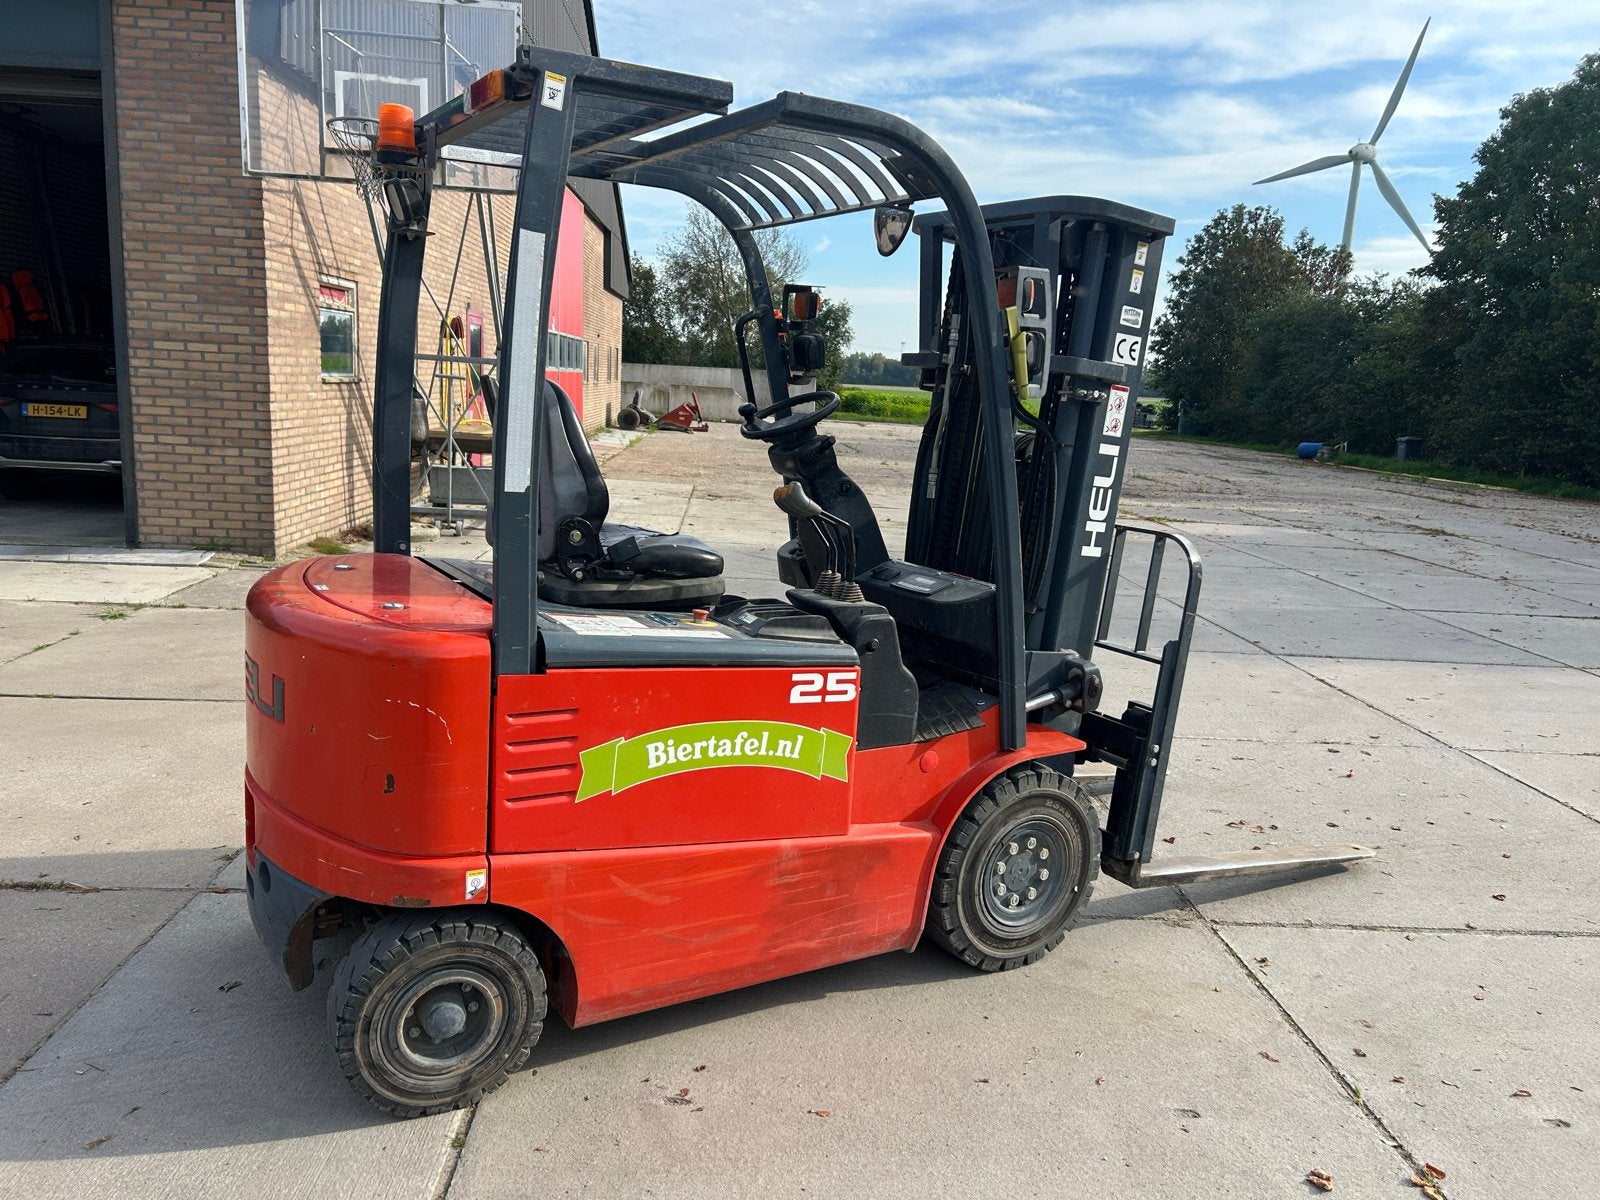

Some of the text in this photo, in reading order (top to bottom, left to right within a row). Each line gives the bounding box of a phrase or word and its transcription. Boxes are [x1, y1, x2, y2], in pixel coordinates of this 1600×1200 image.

[1117, 339, 1138, 361] CE
[32, 405, 81, 417] H-154-LK
[1081, 443, 1120, 558] HELI
[789, 672, 857, 704] 25
[646, 731, 803, 769] Biertafel.nl
